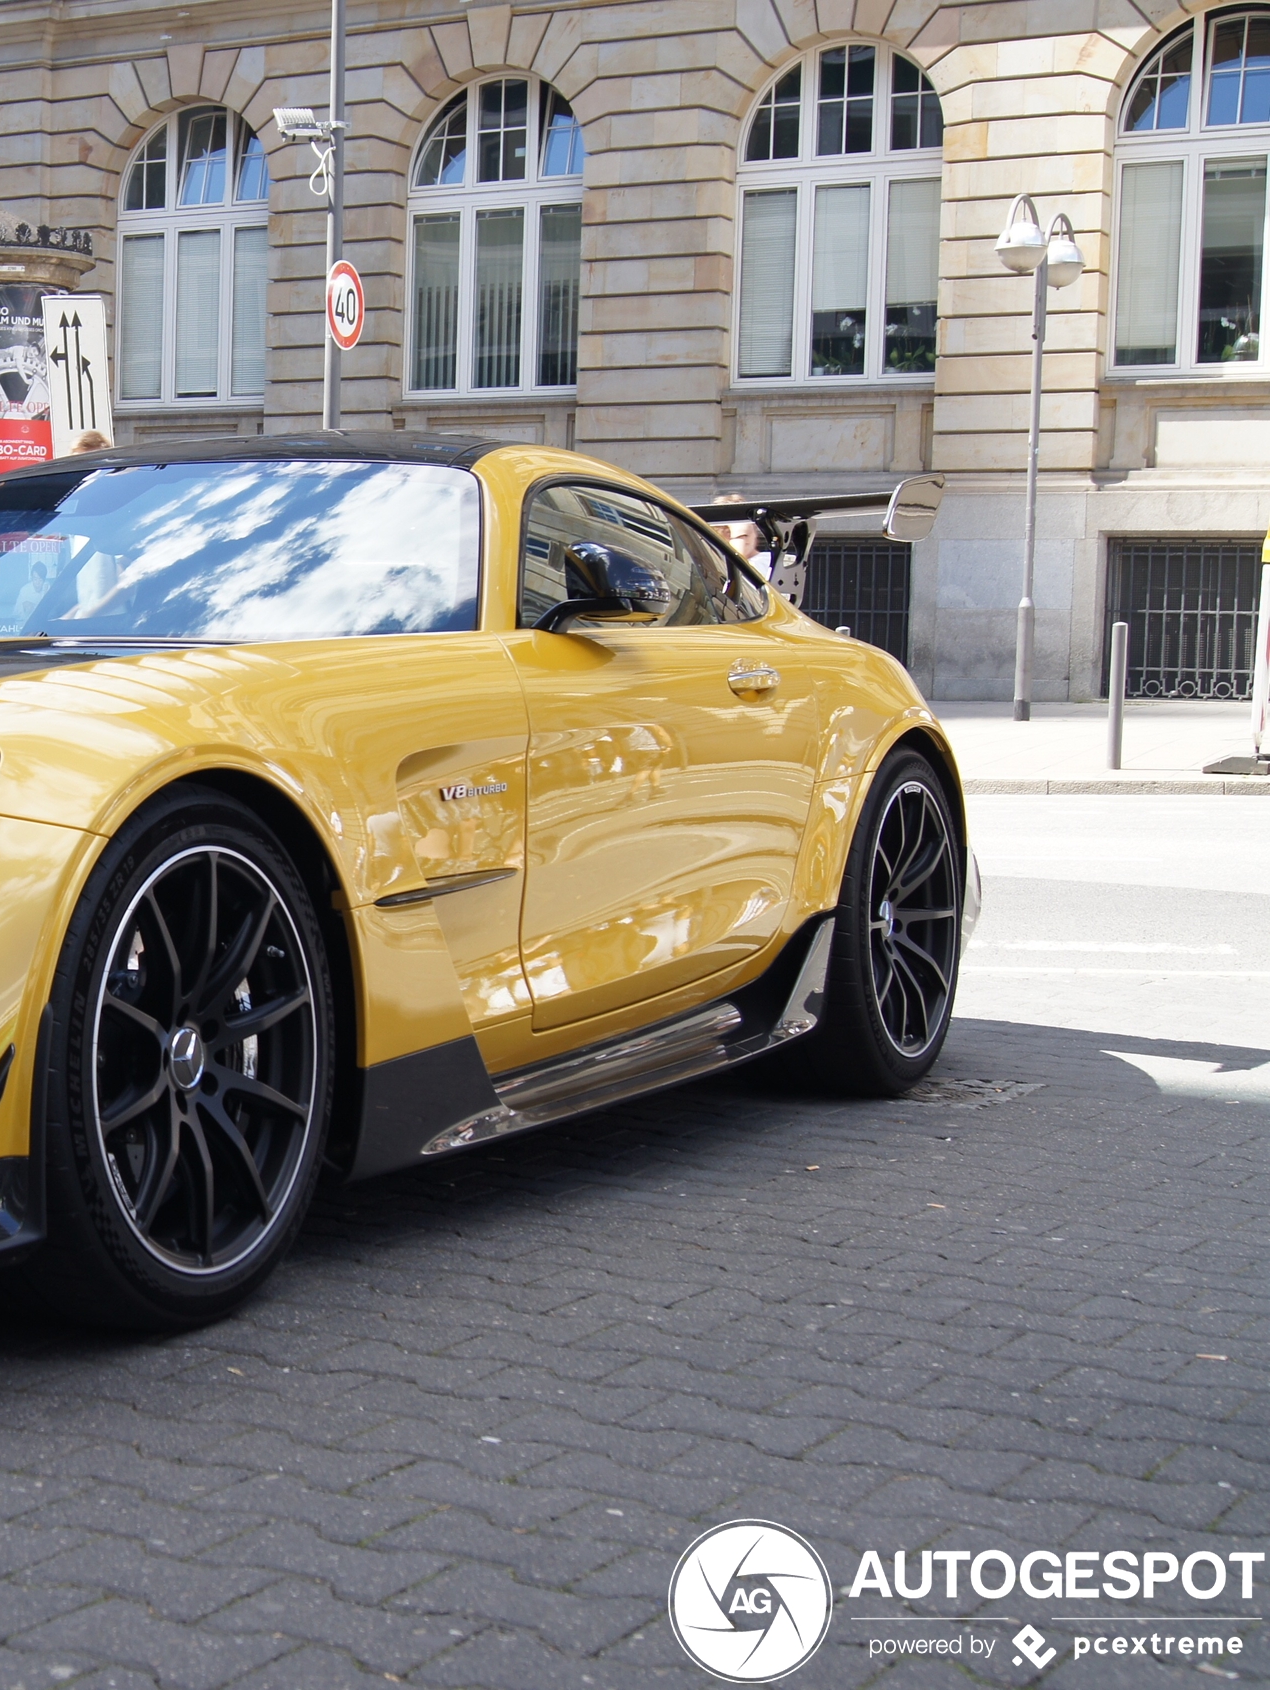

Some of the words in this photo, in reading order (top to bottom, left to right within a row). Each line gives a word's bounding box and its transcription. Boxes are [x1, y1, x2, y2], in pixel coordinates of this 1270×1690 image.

[335, 288, 355, 325] 40
[11, 317, 31, 325] UND
[30, 540, 57, 553] OPER
[440, 786, 467, 801] V8
[468, 783, 508, 797] BITURBO
[83, 897, 111, 973] 285/35
[110, 871, 125, 899] ZR
[123, 855, 135, 874] 19
[69, 990, 89, 1158] MICHELIN
